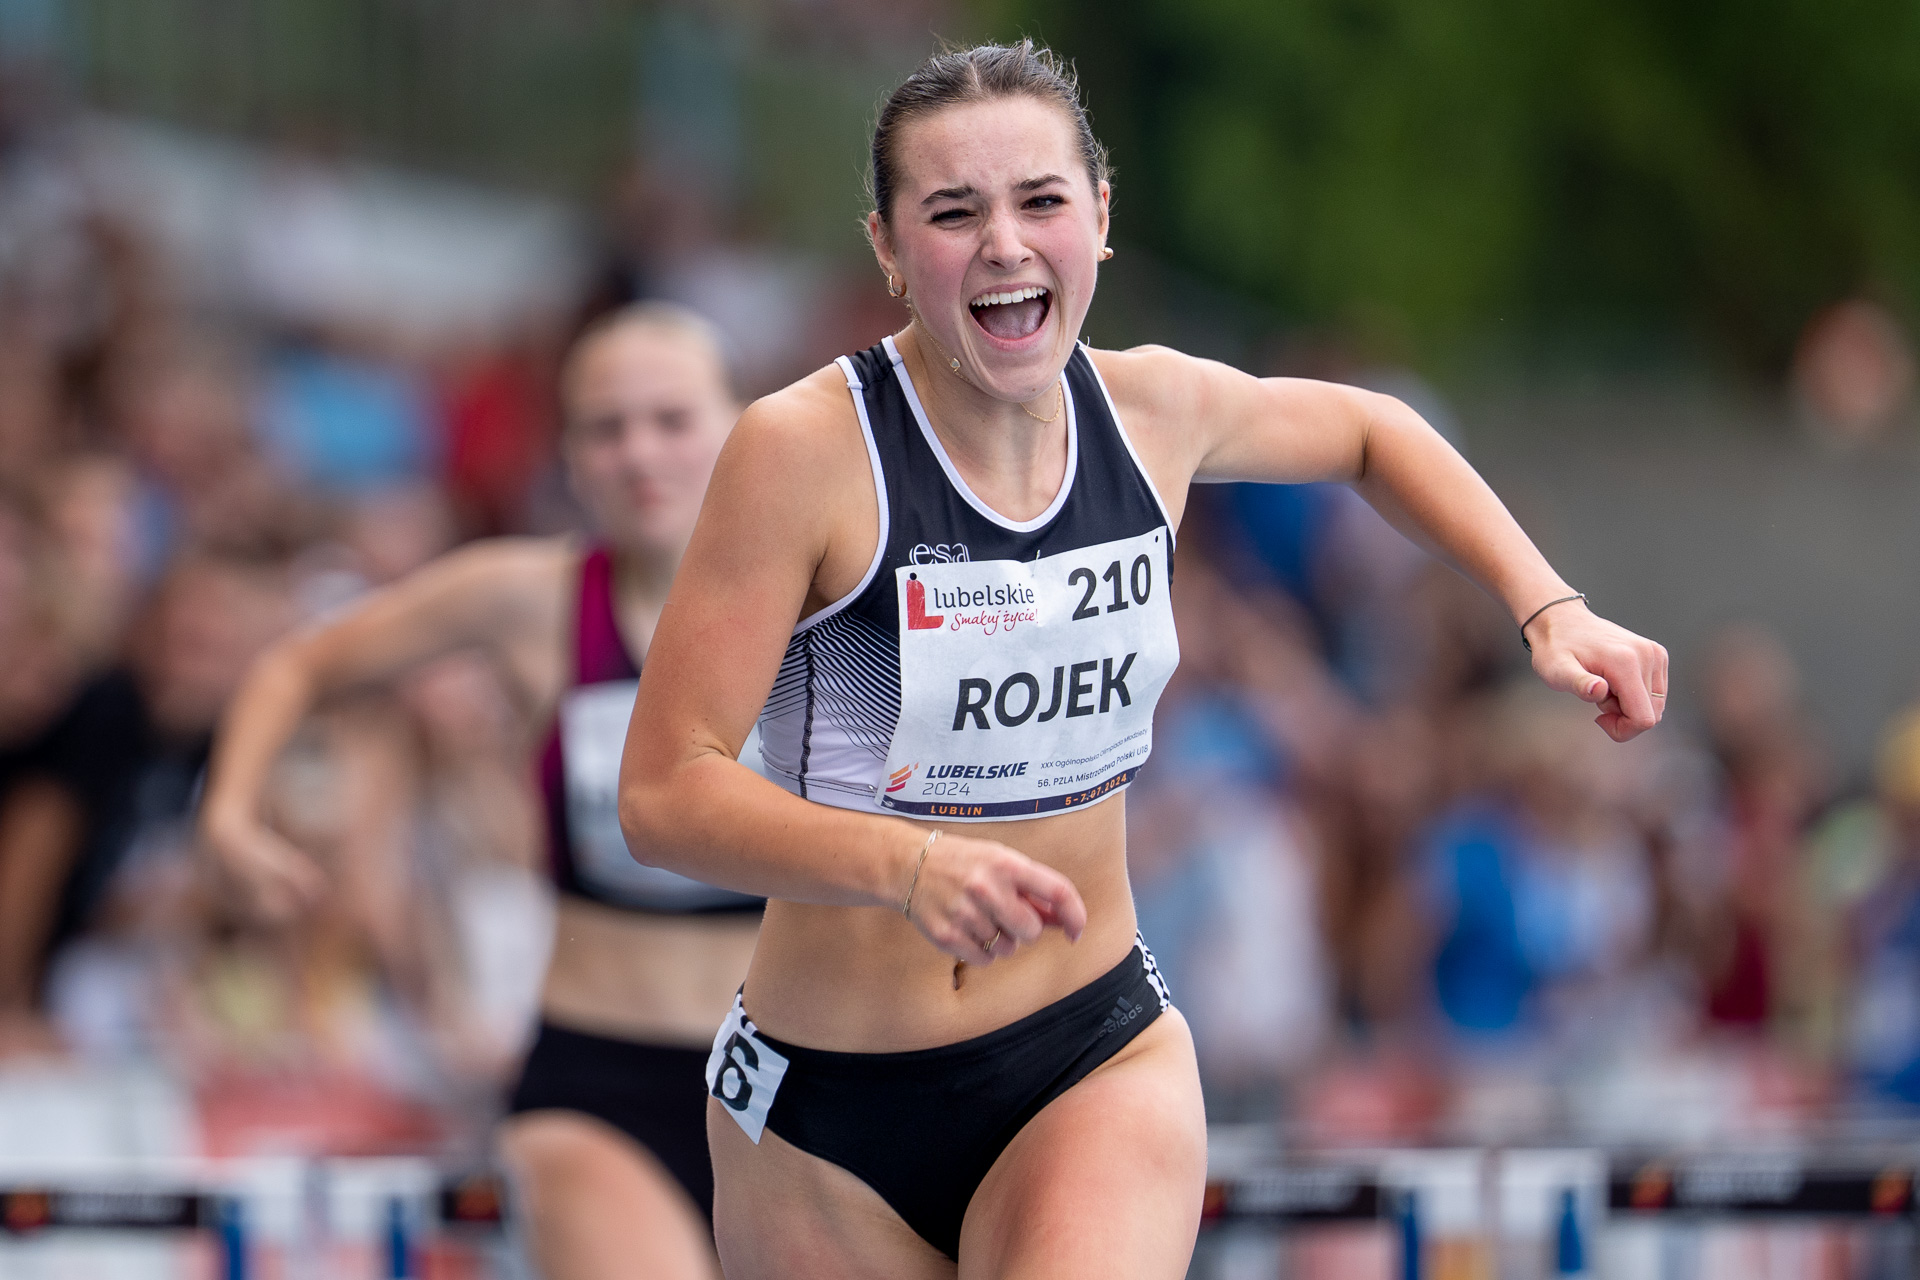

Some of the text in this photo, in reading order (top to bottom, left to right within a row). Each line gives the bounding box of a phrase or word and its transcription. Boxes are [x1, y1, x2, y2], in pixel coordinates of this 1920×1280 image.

[909, 543, 970, 565] esa
[934, 583, 1035, 608] lubelskie
[1067, 553, 1152, 622] 210
[950, 608, 1039, 635] Smakuj życie!
[952, 652, 1137, 731] ROJEK
[1037, 744, 1149, 788] 56. PZLA Mistrzostwa Polski U18
[1040, 761, 1054, 769] XXX
[1055, 752, 1100, 768] Ogólnopolska
[1100, 740, 1123, 757] Olimpiada
[926, 761, 1029, 779] LUBELSKIE
[922, 782, 970, 796] 2024
[930, 805, 983, 815] LUBLIN
[712, 1030, 759, 1111] 6
